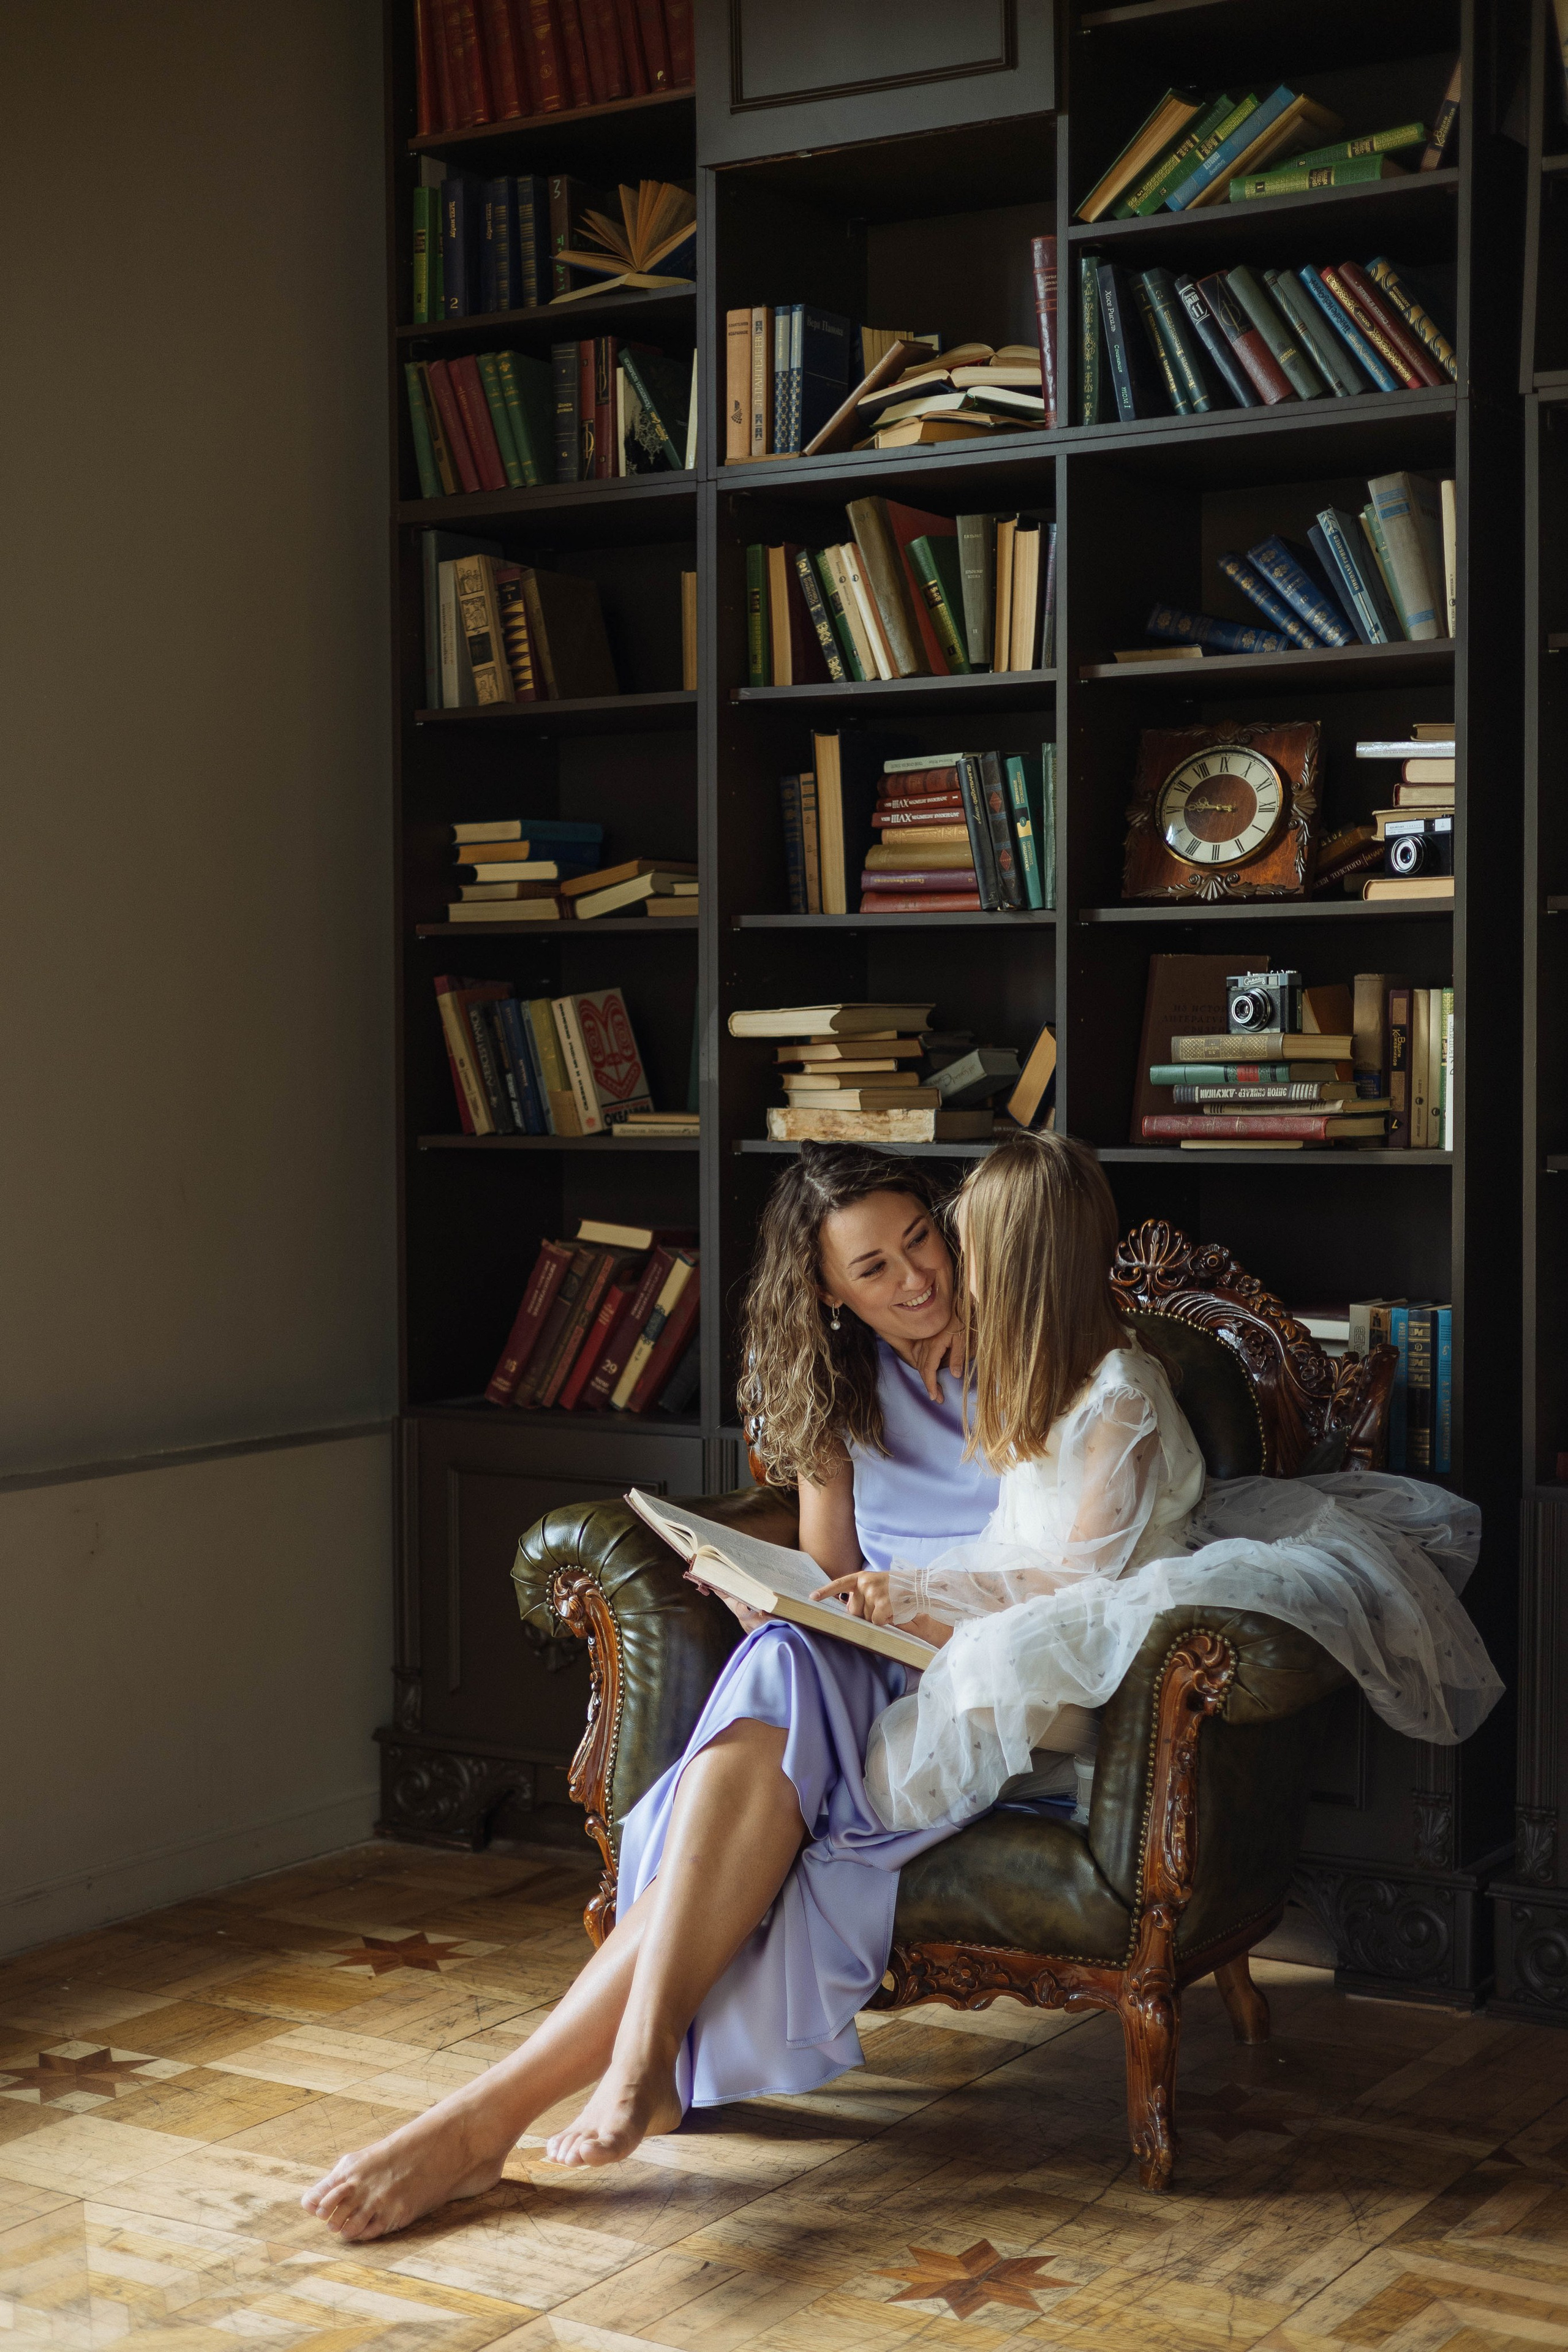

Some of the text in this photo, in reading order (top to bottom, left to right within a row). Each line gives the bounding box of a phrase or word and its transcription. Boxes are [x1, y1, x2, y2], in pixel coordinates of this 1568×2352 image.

[450, 297, 458, 309] 2
[1104, 290, 1114, 307] Хосе
[1186, 294, 1200, 307] ЗОЛЯ
[1191, 302, 1204, 318] 11
[1107, 307, 1117, 333] Рисаль
[1114, 344, 1123, 374] Сочинения
[1333, 540, 1359, 586] НИКОЛАЙ ГРИБАЧЕВ
[966, 763, 978, 805] ФЕЙХТВАНГЕР
[892, 799, 909, 809] XVIII
[891, 813, 912, 823] XVIII
[1329, 857, 1363, 882] ТОЛСТОГО
[1244, 976, 1265, 985] Смена
[1161, 1014, 1226, 1023] ЛИТЕРАТУР
[1199, 1088, 1287, 1099] ЭПТОН СИНКЛЕР ДЖУНГЛИ
[1354, 1325, 1366, 1359] АЕВ
[601, 1359, 617, 1374] 29
